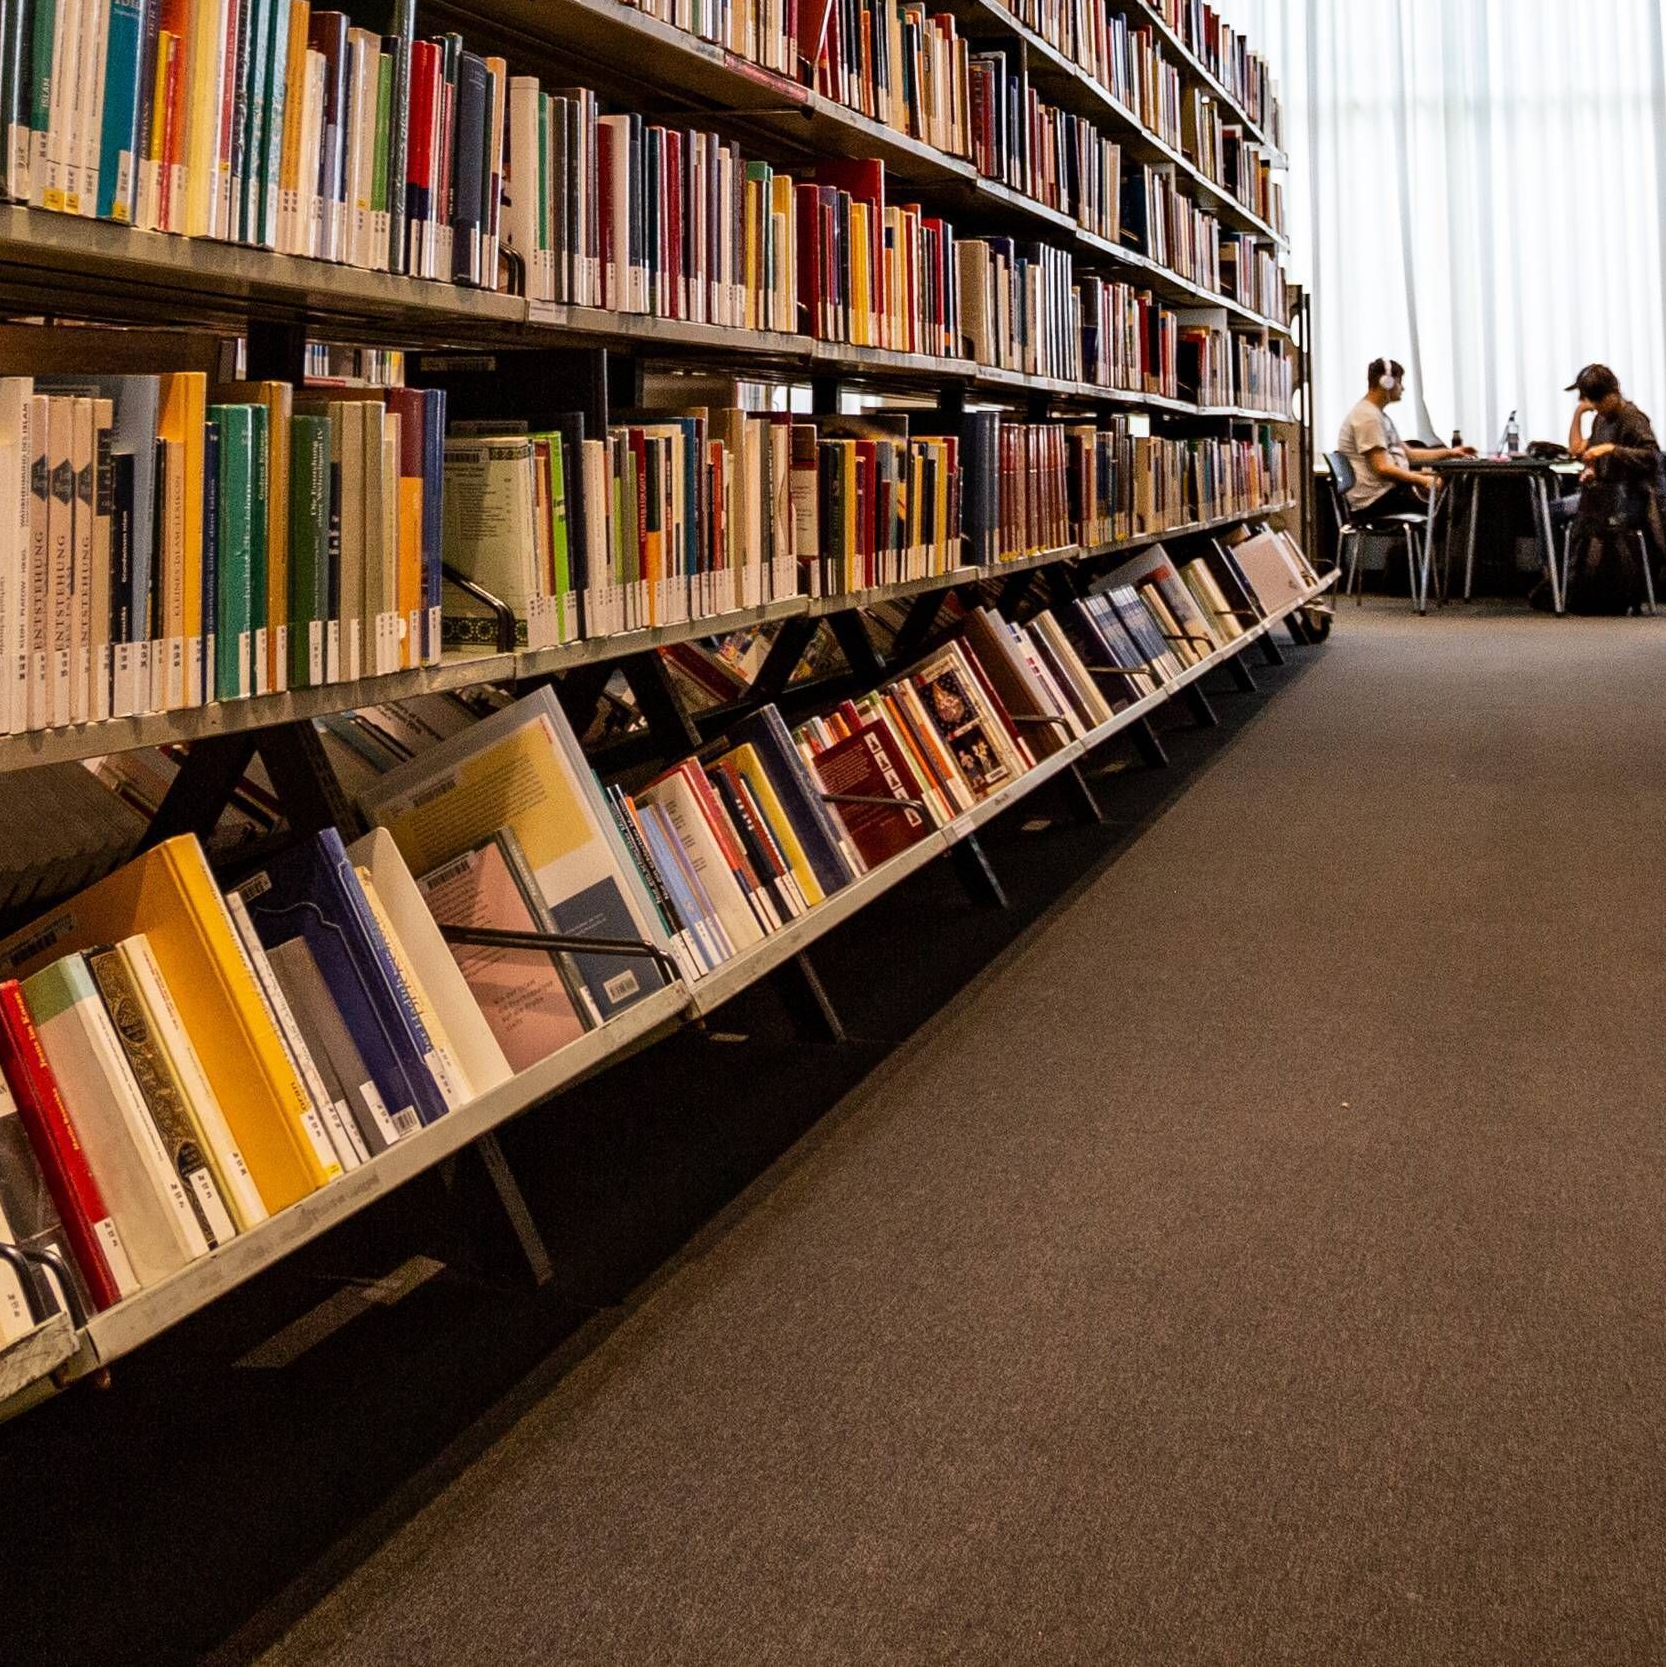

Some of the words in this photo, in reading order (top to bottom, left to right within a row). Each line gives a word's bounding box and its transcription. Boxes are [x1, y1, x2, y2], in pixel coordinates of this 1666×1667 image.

[37, 77, 53, 106] ISLAM
[32, 531, 43, 651] ENTSTEHUNG
[53, 534, 65, 652] ENTSTEHUNG
